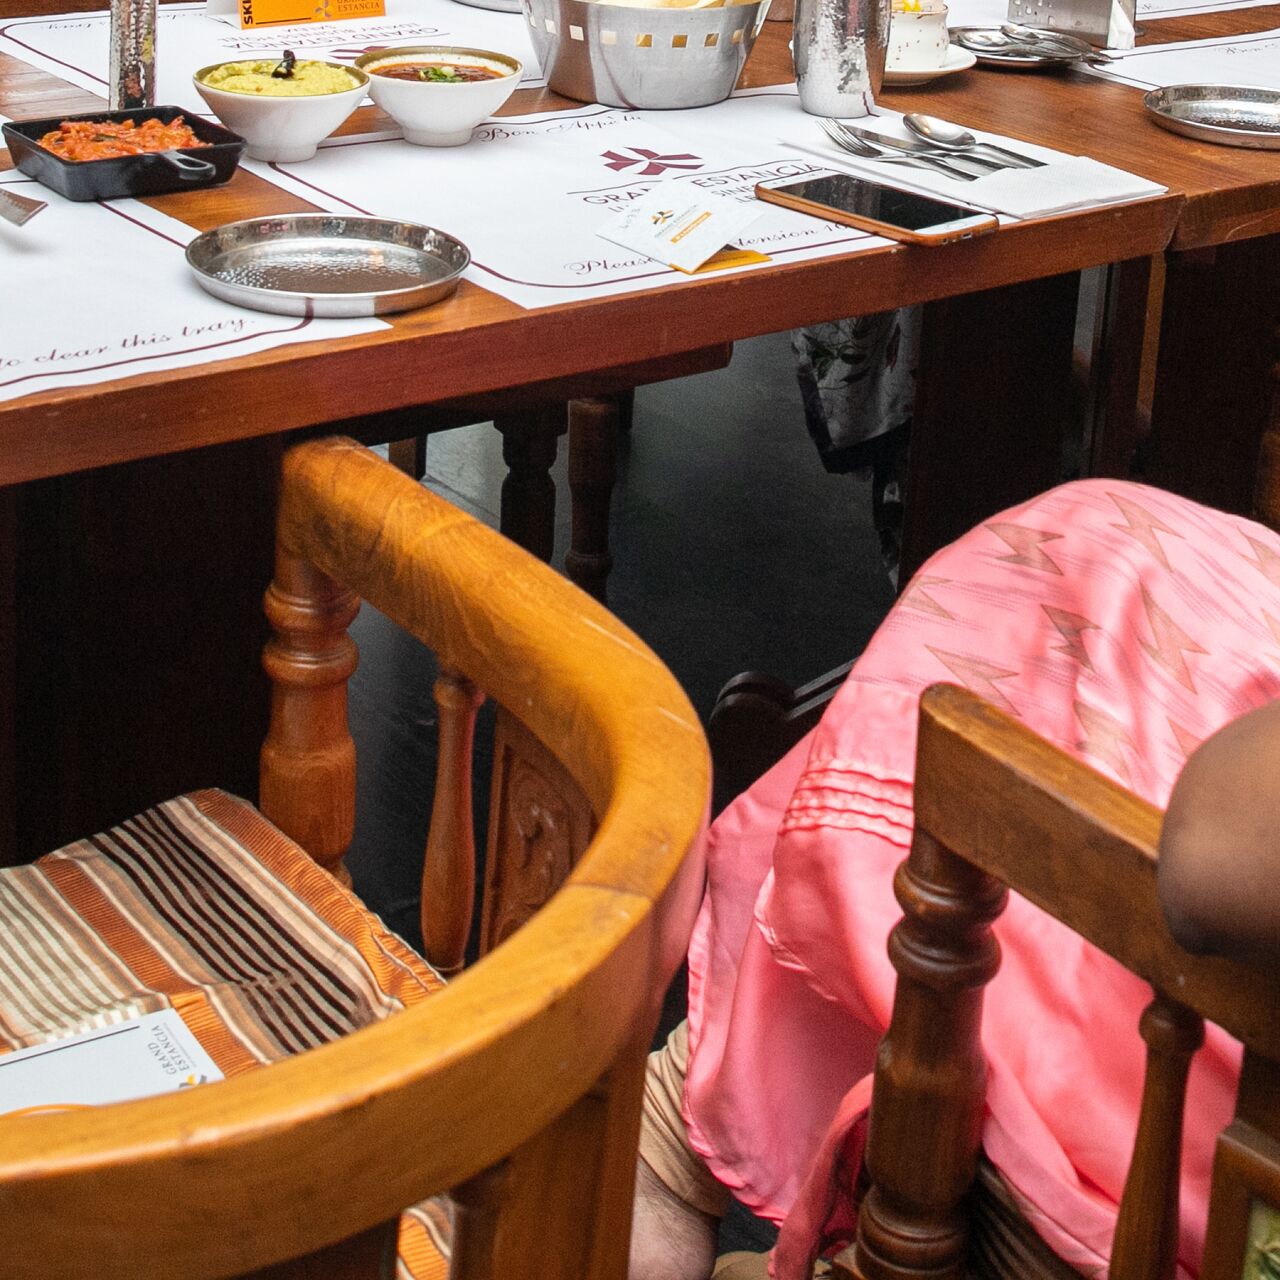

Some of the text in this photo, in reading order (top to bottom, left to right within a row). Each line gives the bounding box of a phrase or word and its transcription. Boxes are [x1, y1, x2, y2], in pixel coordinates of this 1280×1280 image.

[338, 2, 380, 12] ESTANCIA
[222, 27, 438, 49] GRAND ESTANCIA
[583, 186, 652, 205] GRA
[34, 344, 111, 363] clear
[120, 333, 173, 348] this
[147, 1042, 177, 1075] GRAND
[151, 1024, 190, 1072] ESTANCIA
